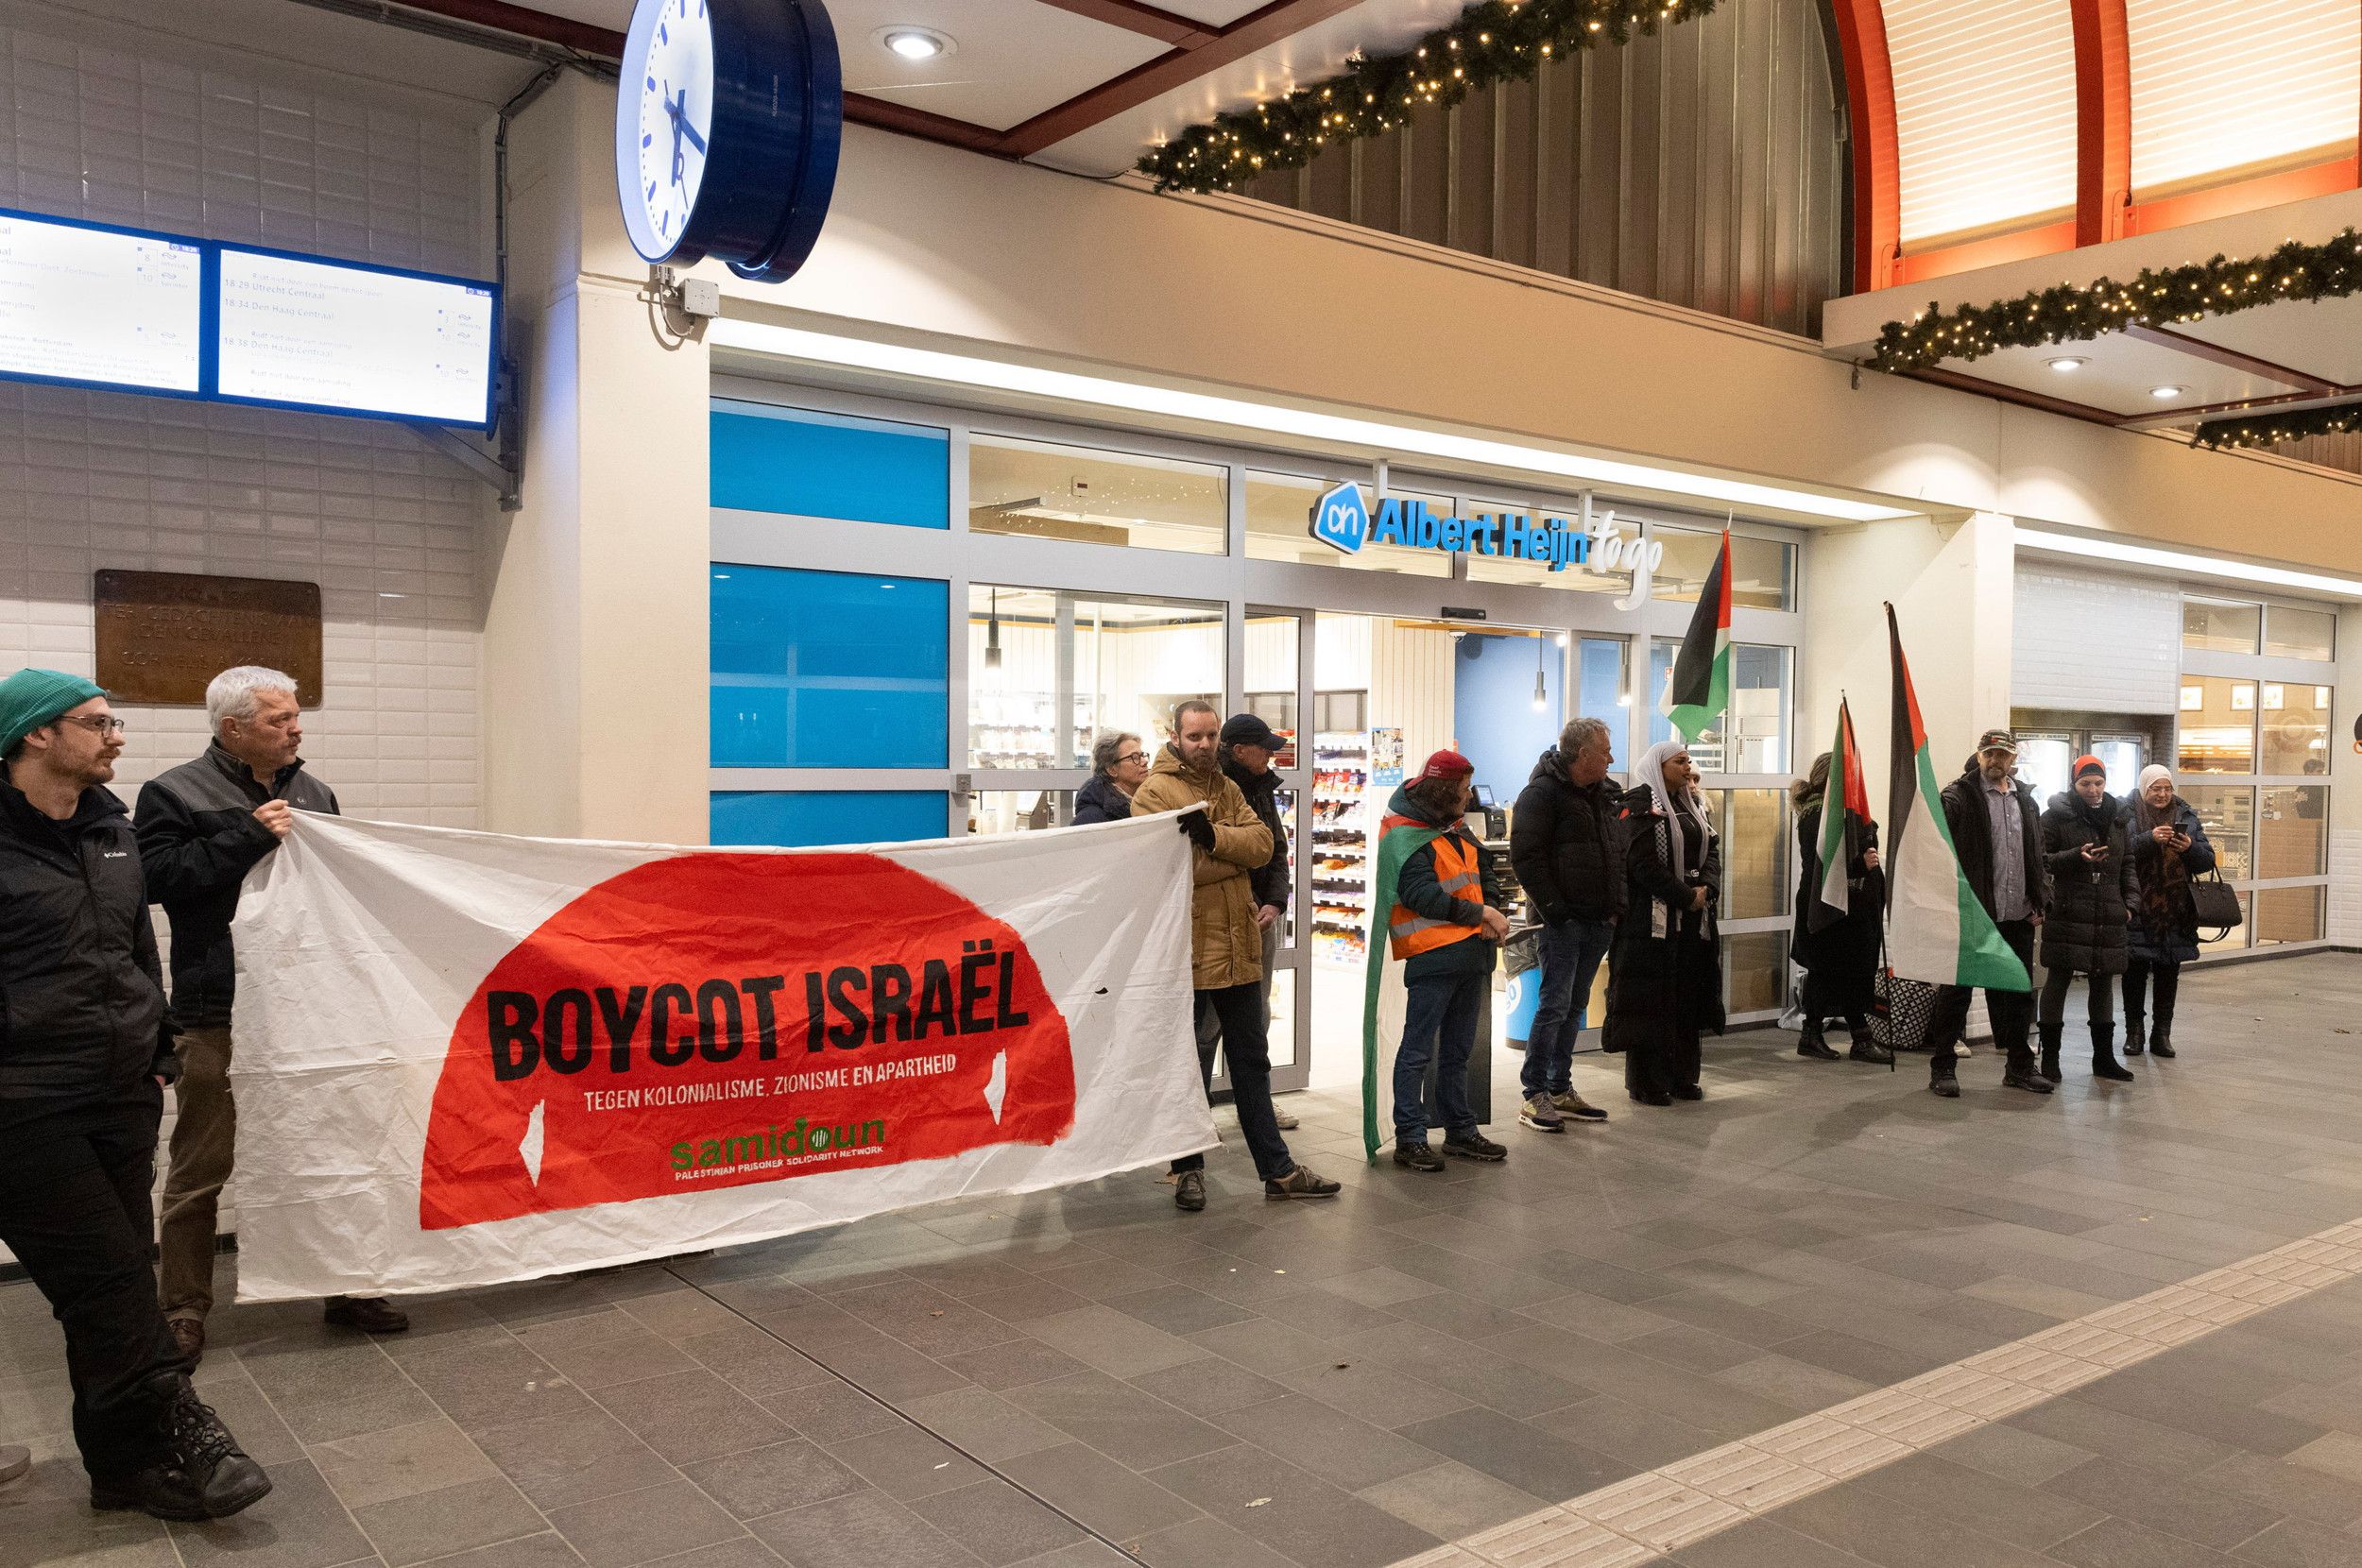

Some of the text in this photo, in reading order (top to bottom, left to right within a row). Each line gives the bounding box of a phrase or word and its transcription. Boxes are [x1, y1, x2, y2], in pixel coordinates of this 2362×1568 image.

[144, 274, 153, 282] 10
[225, 279, 325, 300] 18:29 Utrecht Centraal
[225, 298, 334, 320] 18:34 Den Haag Centraal
[250, 340, 269, 349] Den
[271, 344, 295, 355] Haag
[1372, 498, 1497, 555] Albert
[1503, 513, 1588, 572] Heijn
[487, 939, 1029, 1082] BOYCOT ISRAËL
[584, 1089, 640, 1112] TEGEN
[774, 1067, 849, 1095] ZIONISME
[853, 1065, 873, 1086] EN
[876, 1053, 956, 1082] APARTHEID
[670, 1117, 885, 1169] samidoun
[675, 1145, 883, 1181] PALESTINIAN PRISONER SOLIDARITY NETWORK
